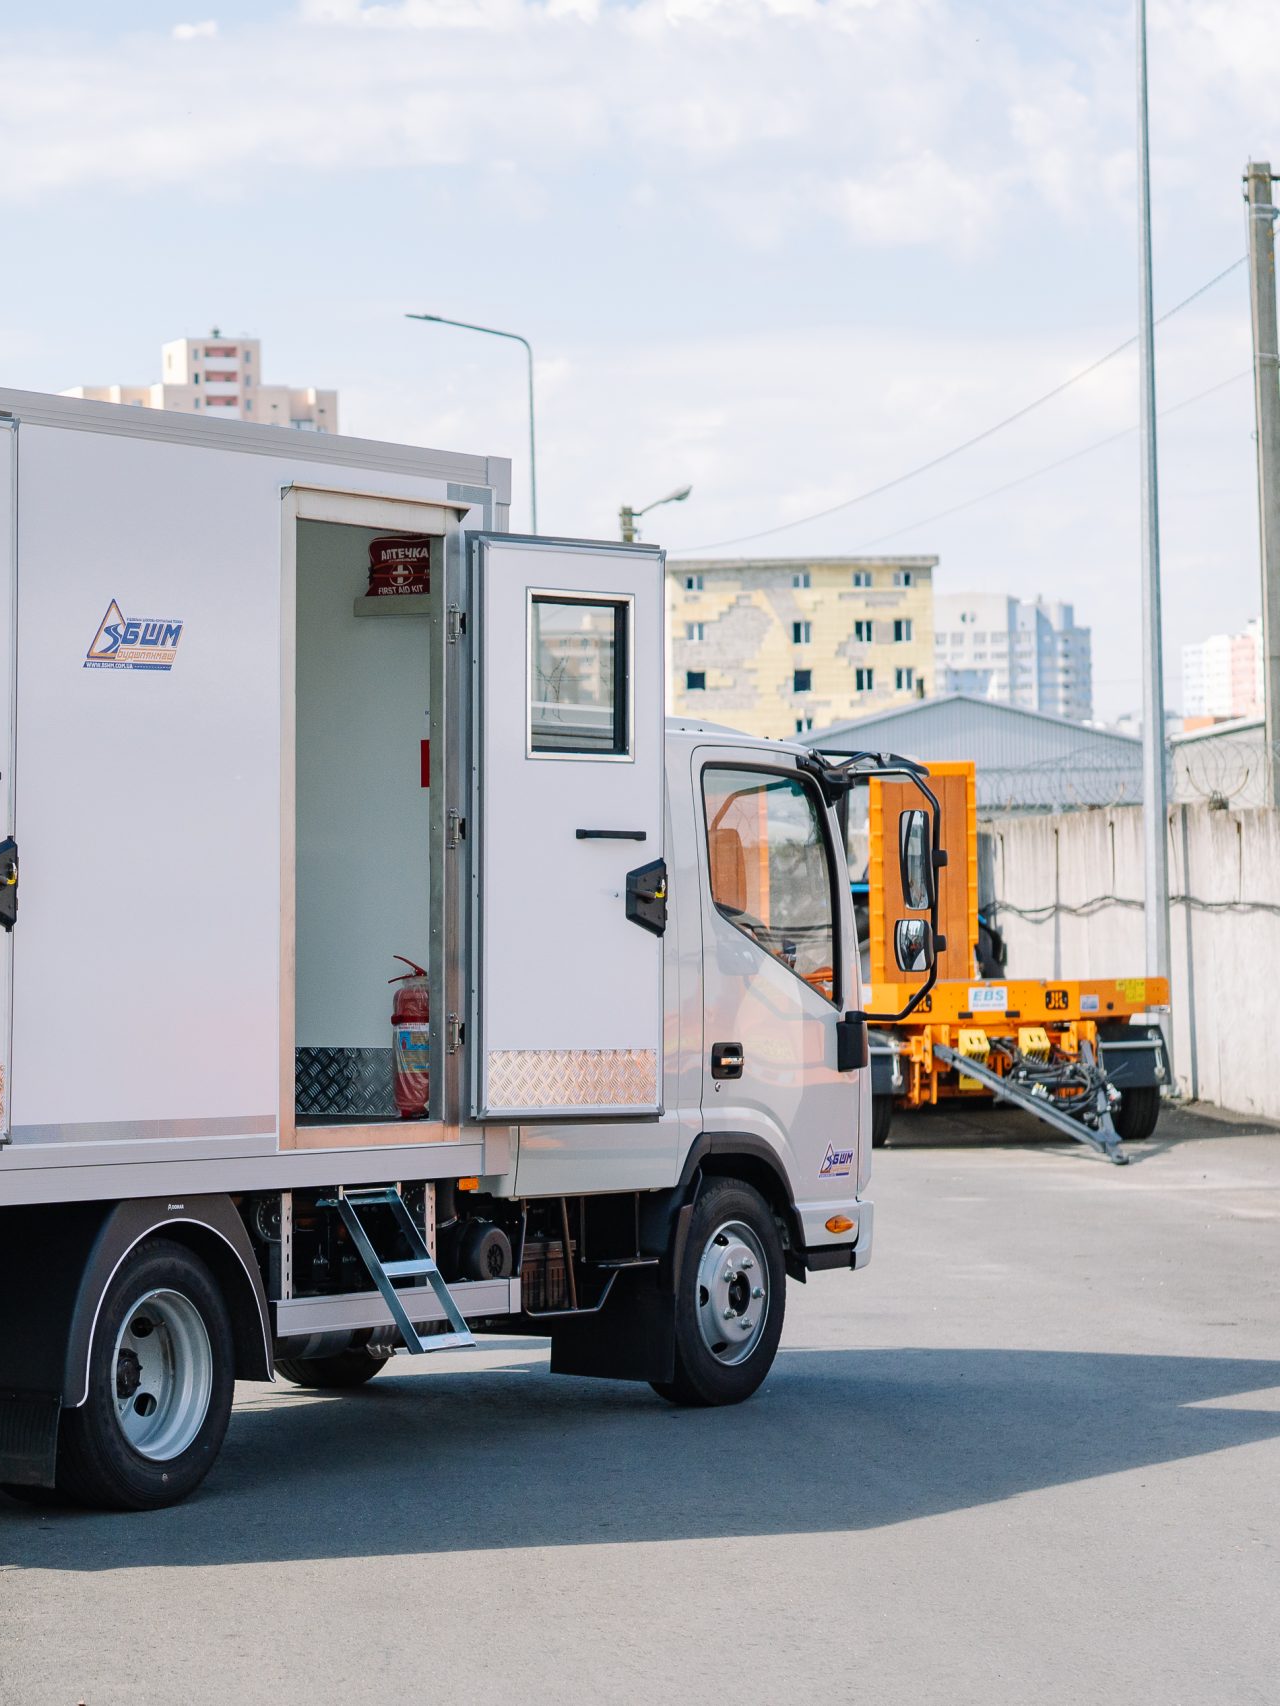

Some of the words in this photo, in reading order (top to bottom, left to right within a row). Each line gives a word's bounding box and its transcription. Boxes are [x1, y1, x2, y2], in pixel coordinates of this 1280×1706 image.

[381, 547, 429, 561] АПТЕЧКА
[378, 586, 397, 595] FIRST
[398, 585, 410, 593] AID
[411, 584, 424, 593] KIT
[973, 989, 1004, 1001] EBS
